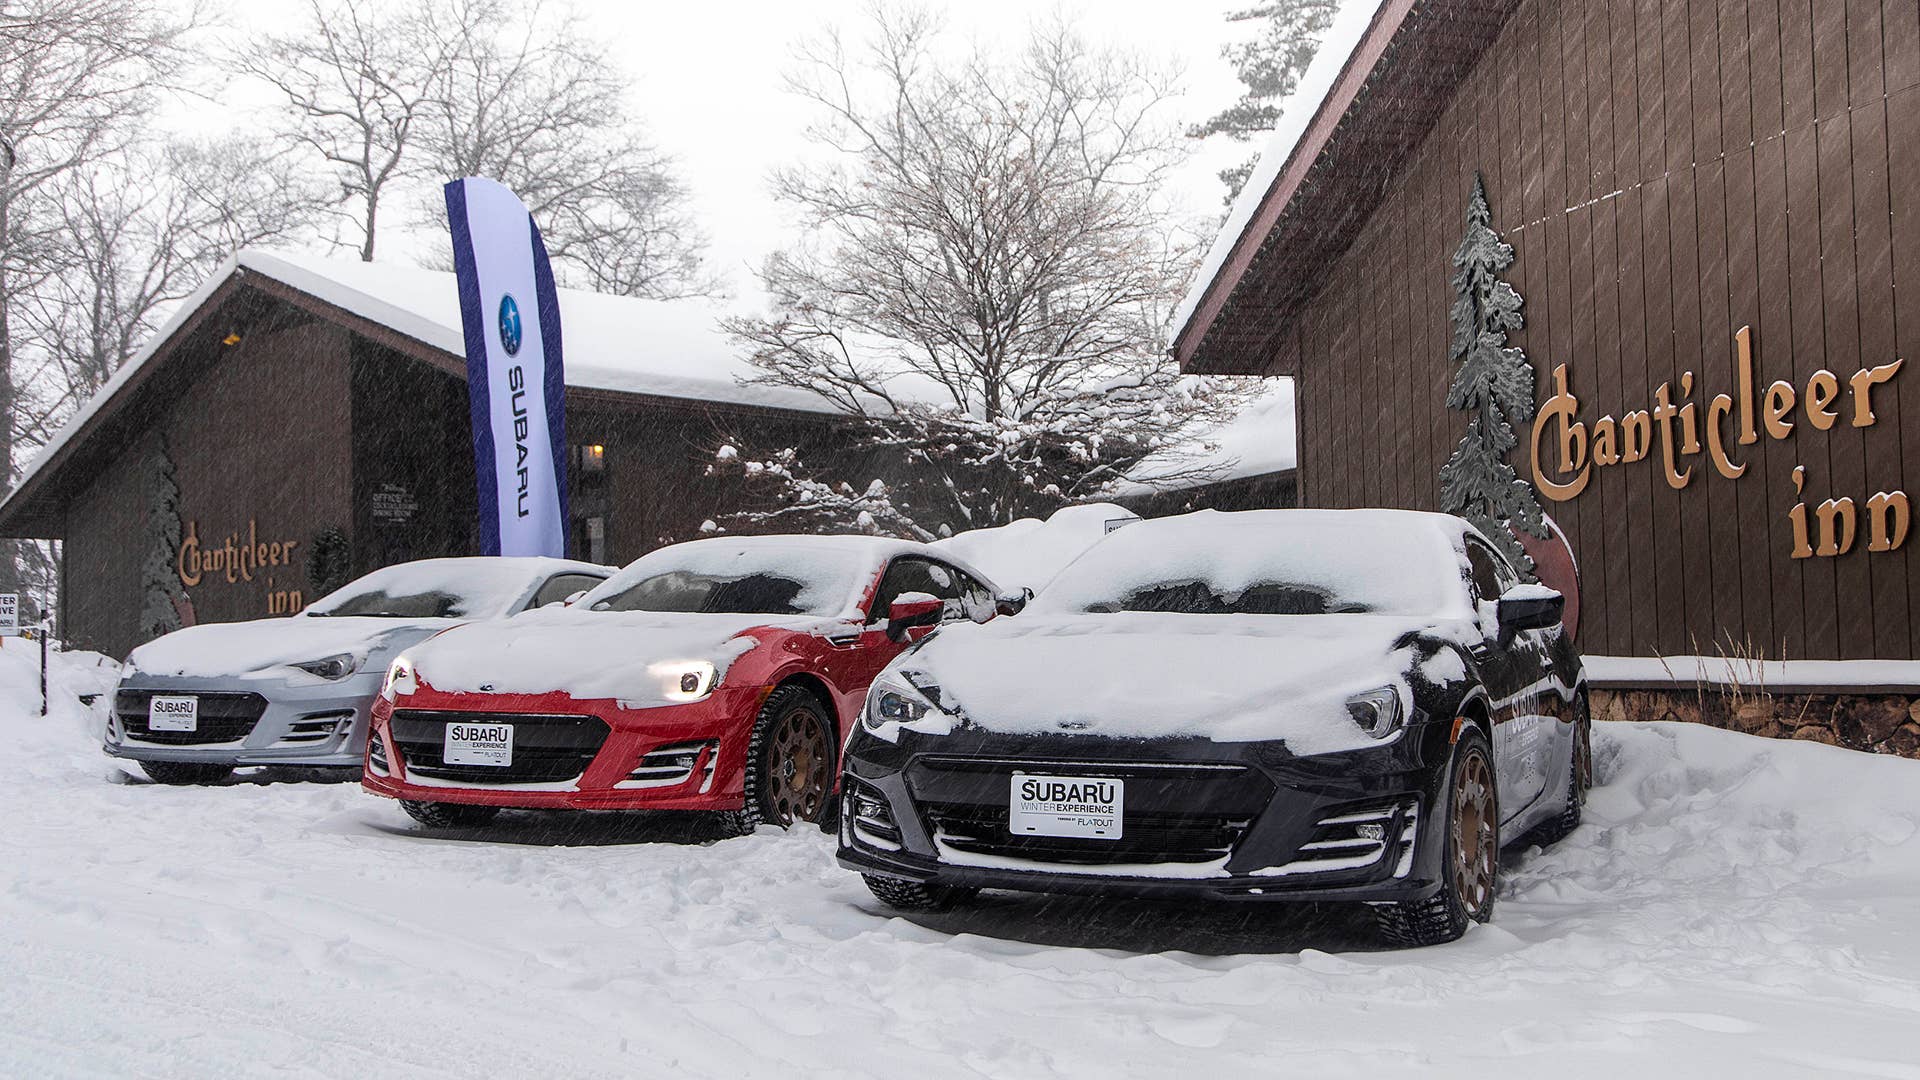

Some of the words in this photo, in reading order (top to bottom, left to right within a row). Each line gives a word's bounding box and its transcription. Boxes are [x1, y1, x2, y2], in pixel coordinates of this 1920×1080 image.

[1530, 324, 1903, 501] Chanticleer
[508, 365, 529, 519] SUBARU
[1789, 464, 1910, 560] inn
[179, 520, 297, 587] Chanticleer
[268, 578, 303, 614] inn
[154, 701, 193, 712] SUBARU
[452, 727, 507, 741] SUBARU
[1021, 782, 1114, 803] SUBARU
[1020, 802, 1056, 812] WINTER
[1056, 803, 1114, 814] EXPERIENCE
[1077, 819, 1113, 827] FLATOUT
